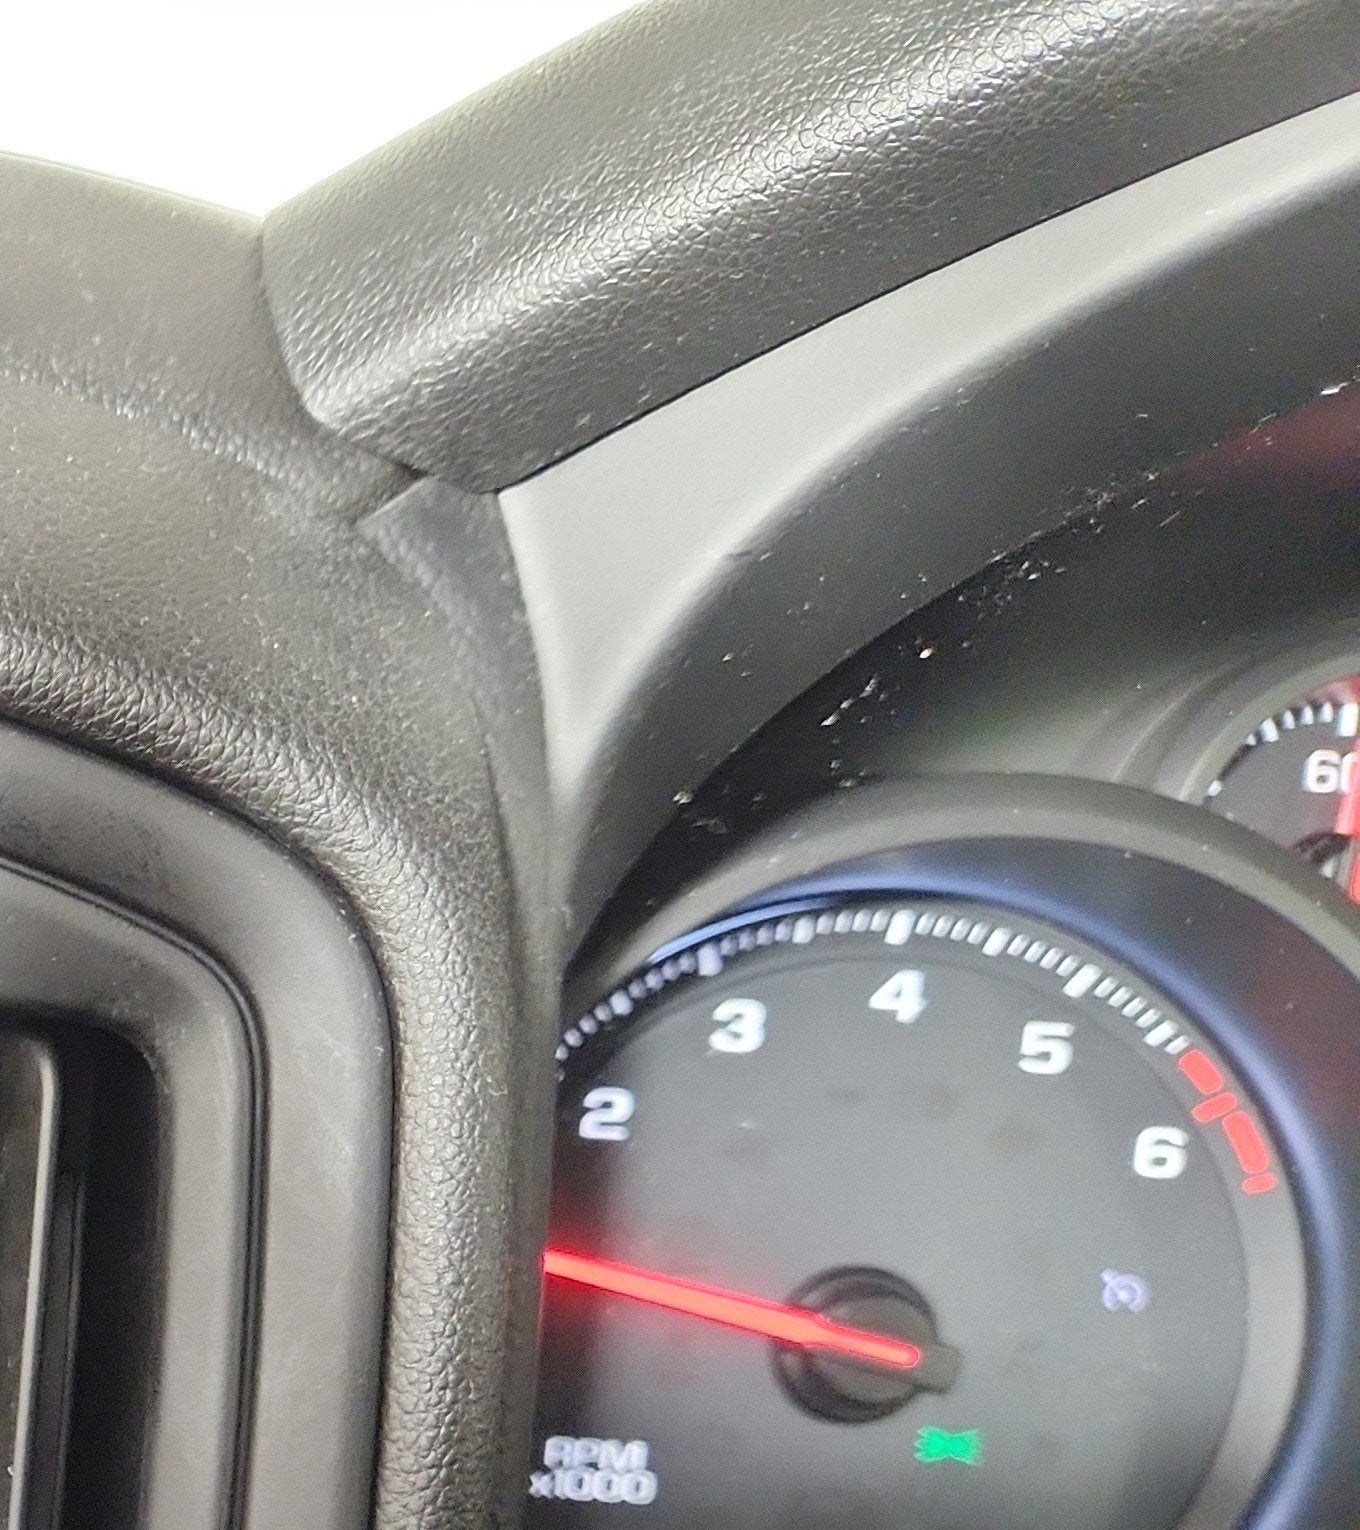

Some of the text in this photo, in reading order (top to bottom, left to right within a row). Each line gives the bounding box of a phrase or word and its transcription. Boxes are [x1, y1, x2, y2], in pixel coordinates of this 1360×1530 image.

[868, 968, 928, 1025] 4
[707, 997, 768, 1055] 3
[1017, 1020, 1076, 1076] 5
[578, 1086, 636, 1142] 2
[1131, 1125, 1189, 1180] 6
[543, 1435, 649, 1471] RPM
